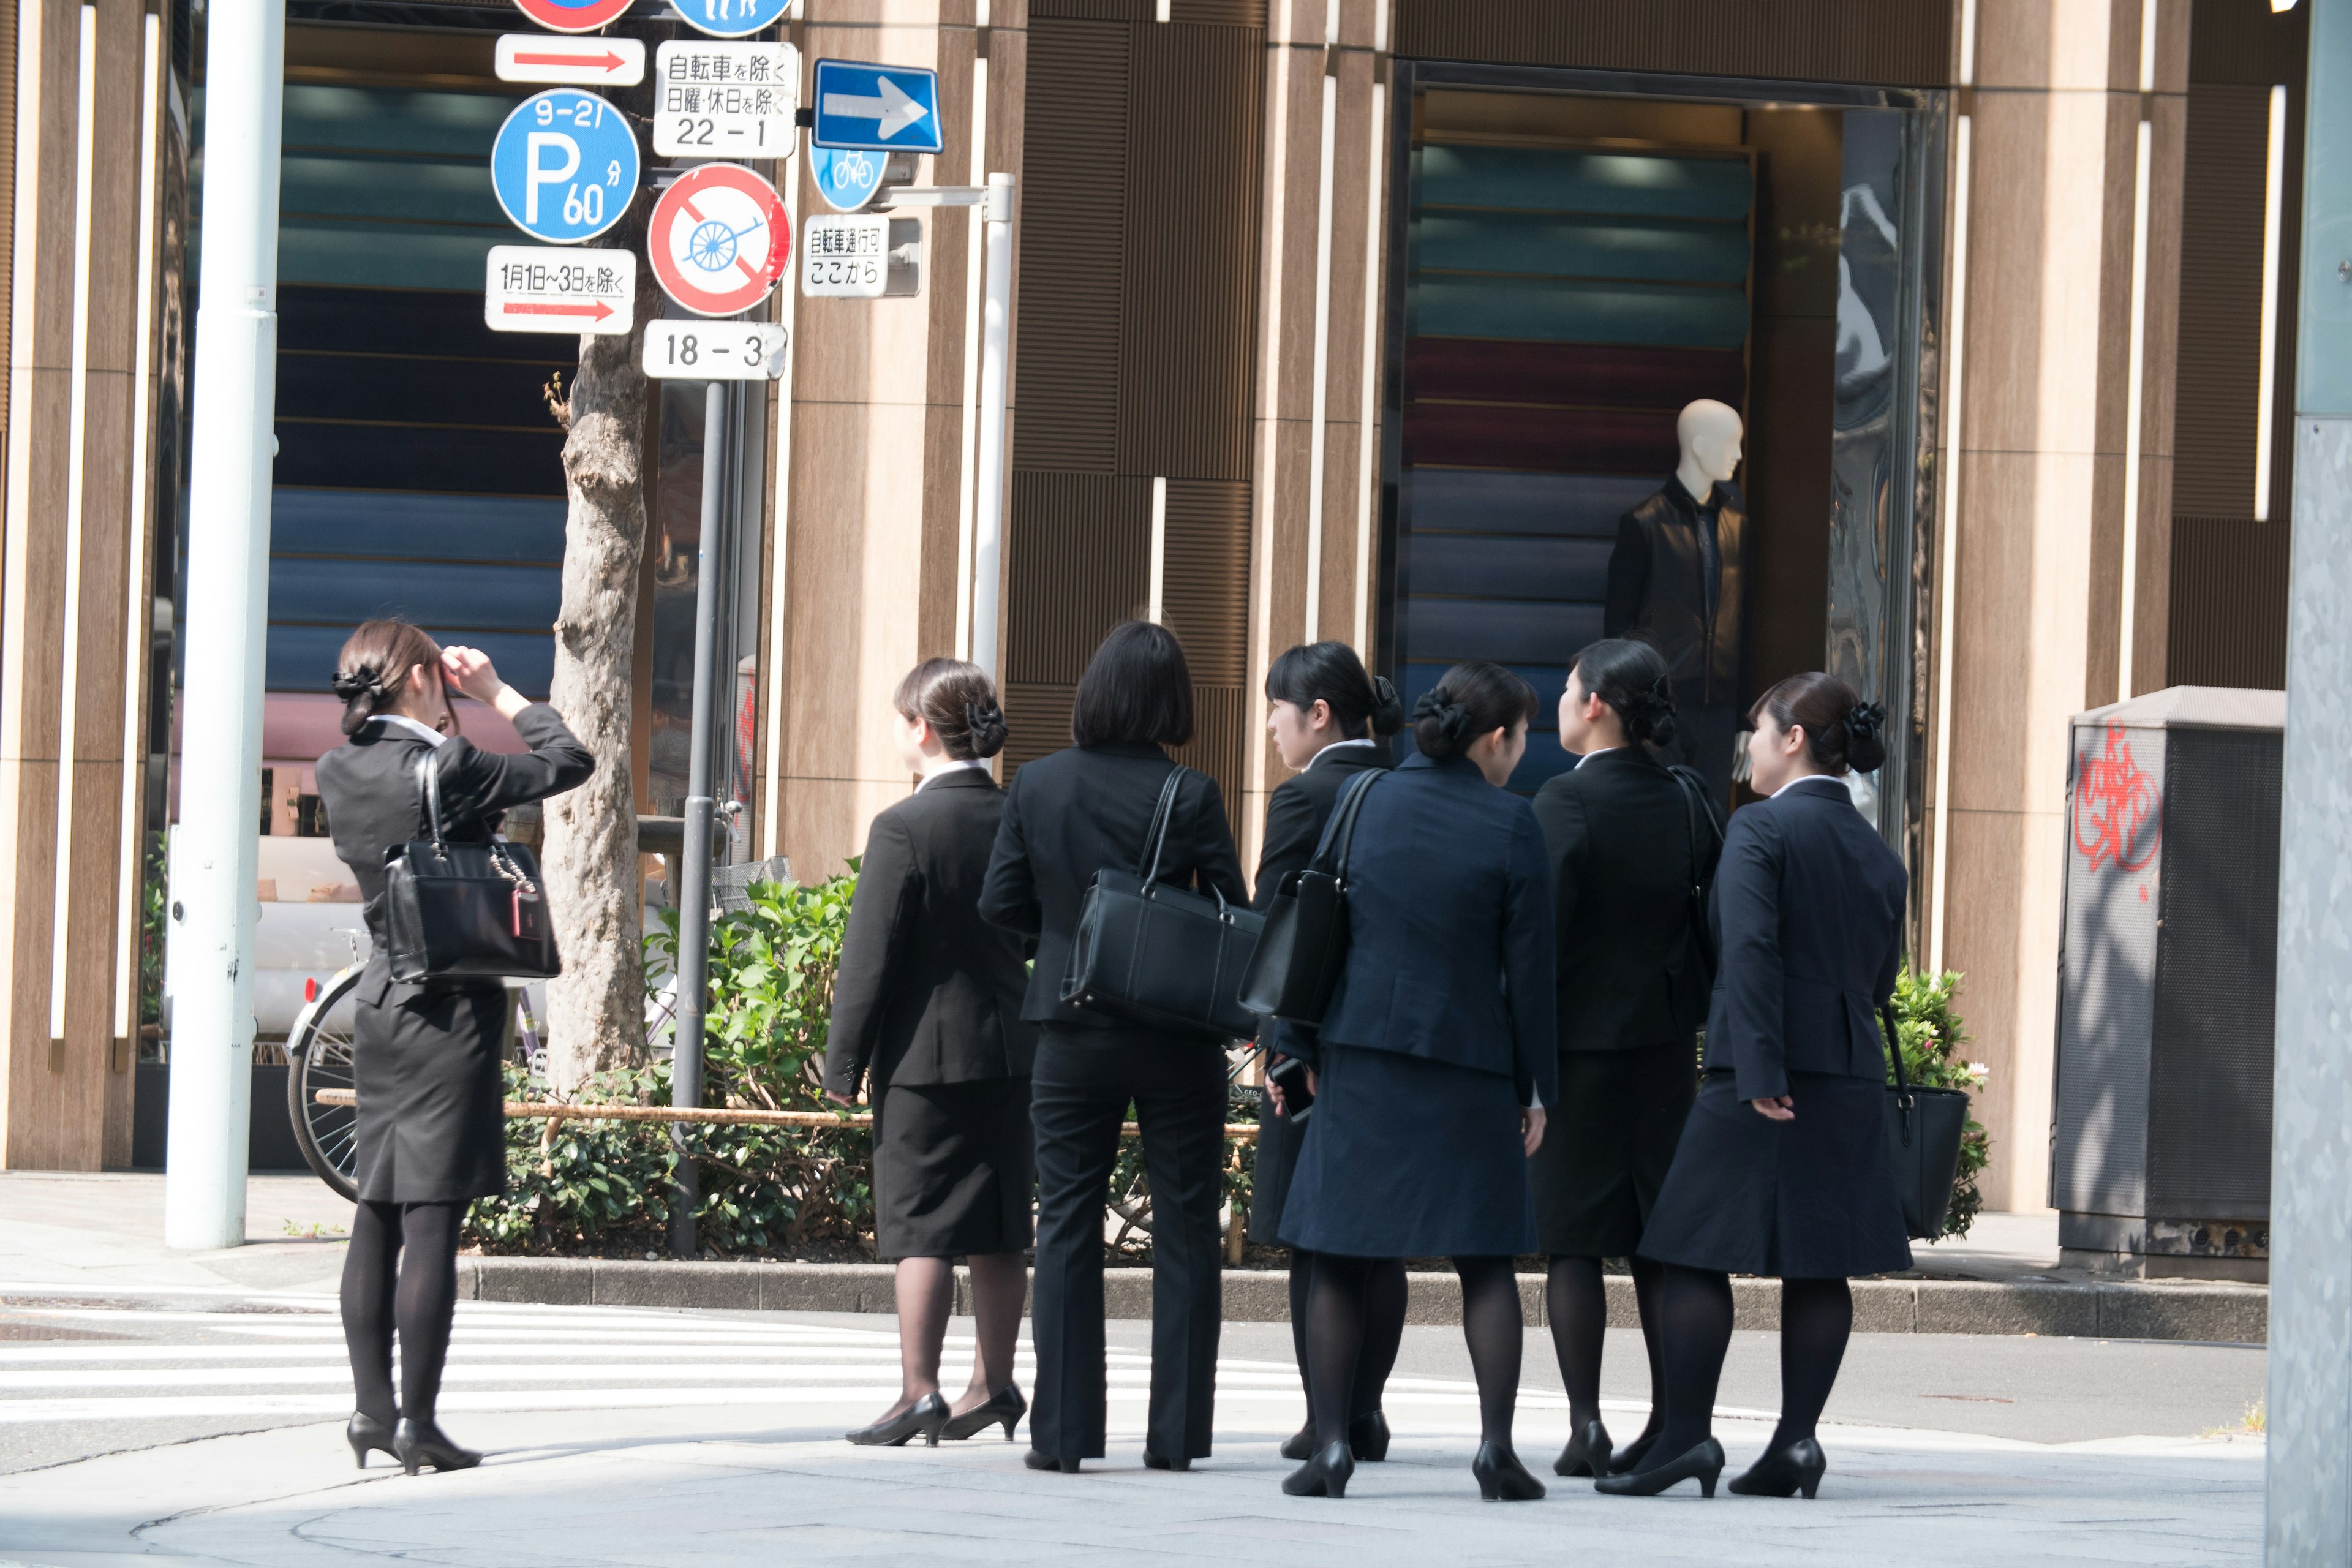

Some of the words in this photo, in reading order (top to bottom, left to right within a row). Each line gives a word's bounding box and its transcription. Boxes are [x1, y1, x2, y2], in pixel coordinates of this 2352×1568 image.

[669, 53, 785, 81] 自転車を除く
[535, 99, 604, 129] 9-21
[526, 132, 581, 225] P
[811, 227, 880, 254] 自転車通行可
[811, 260, 878, 284] ここから
